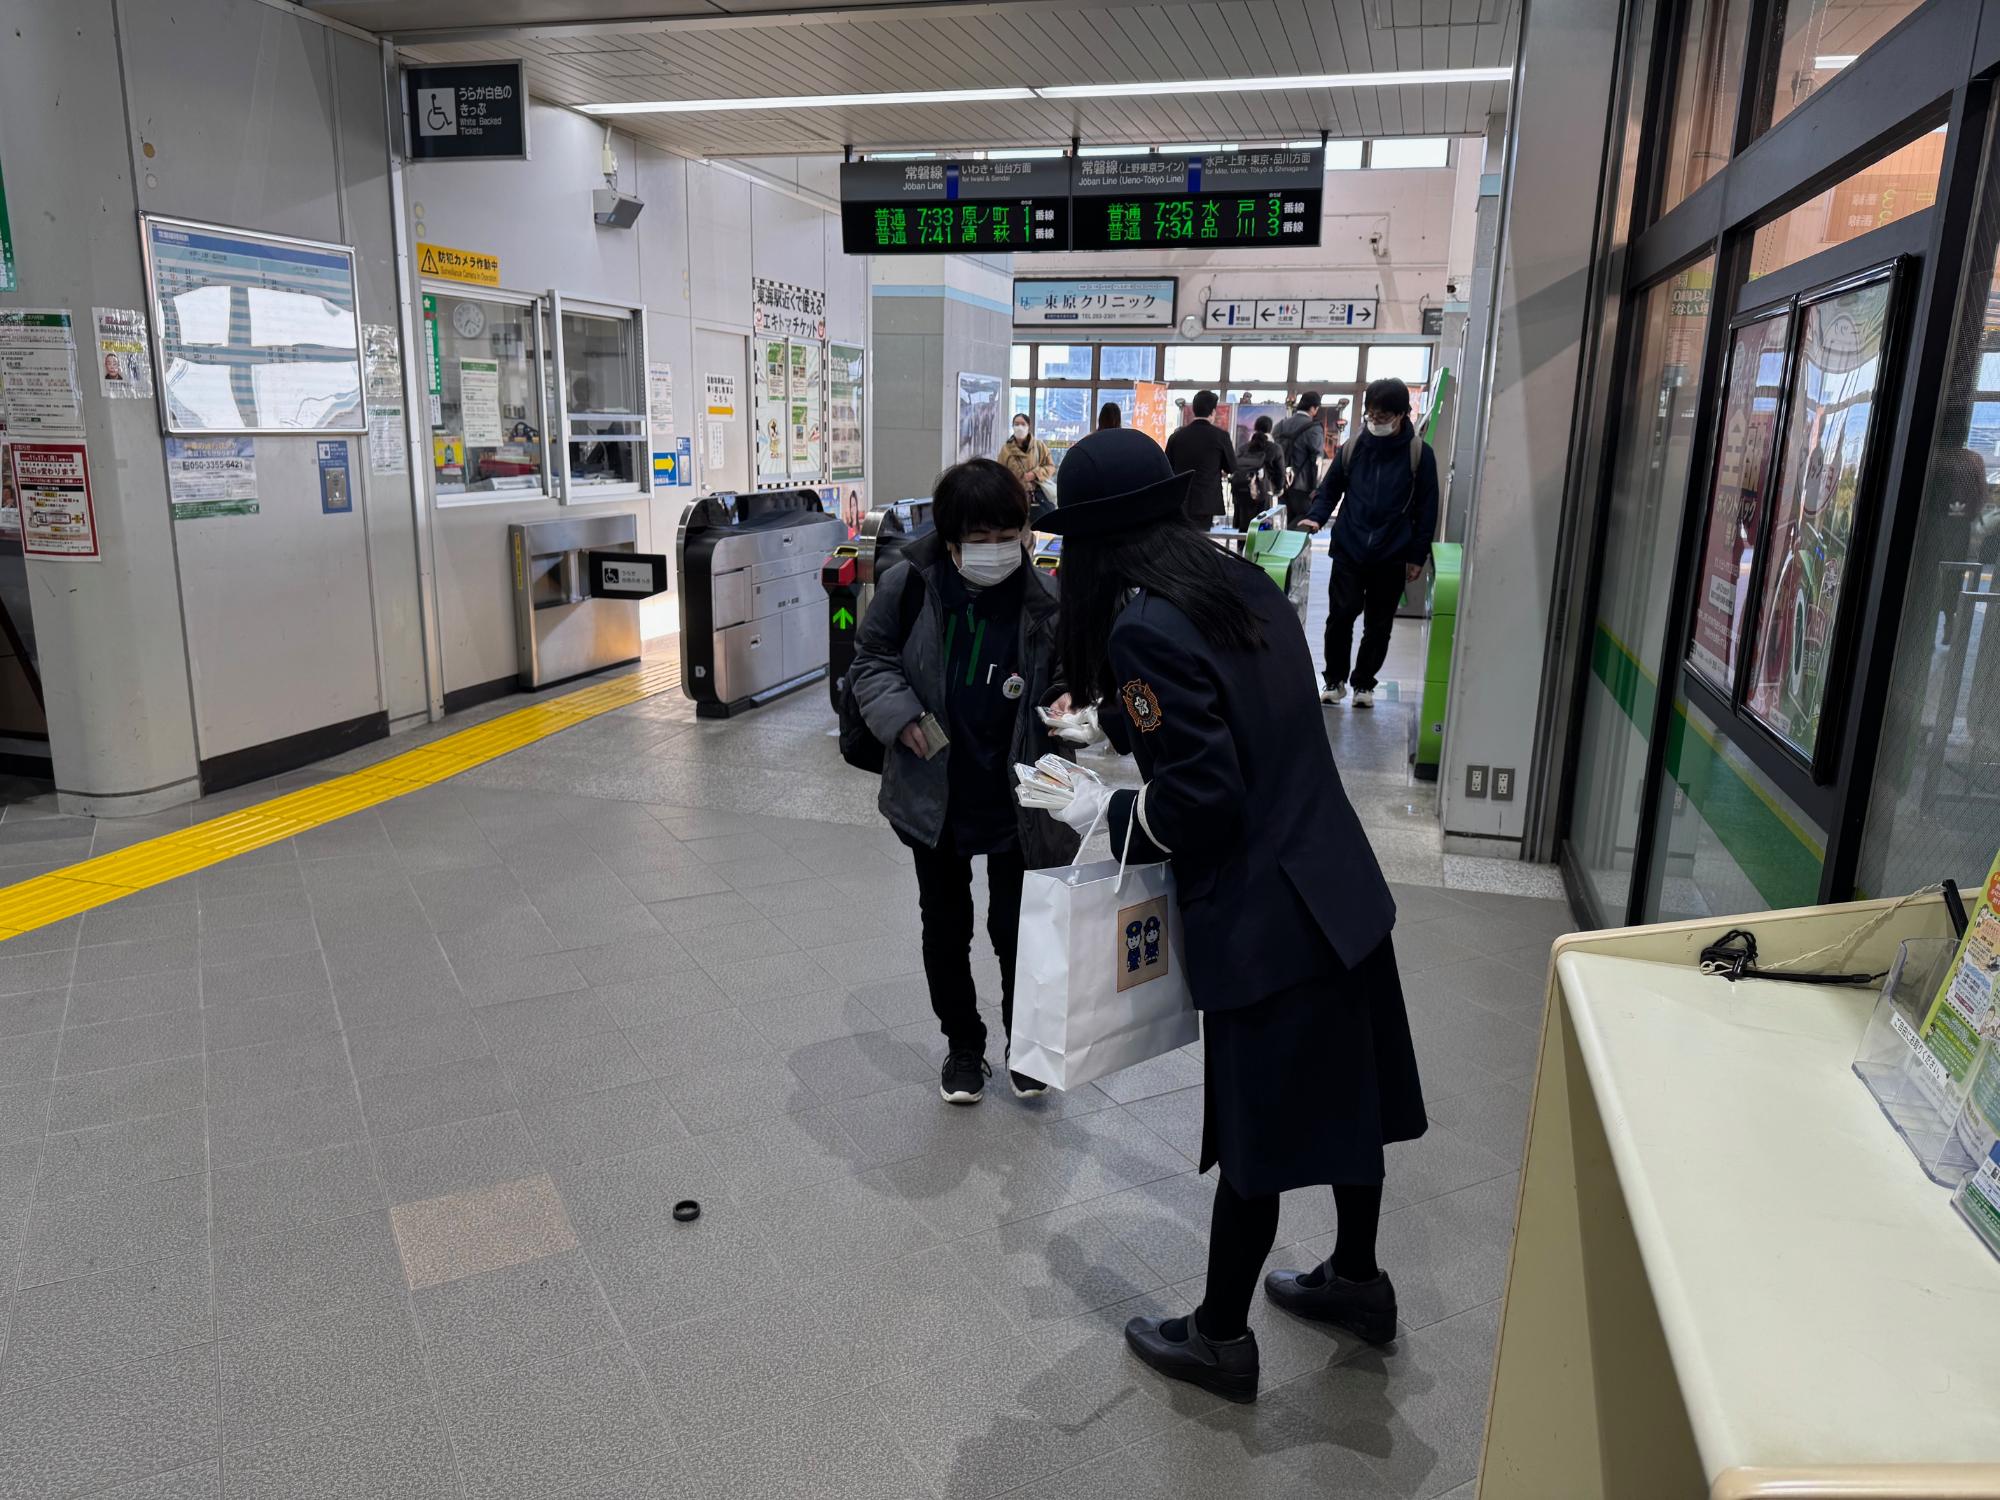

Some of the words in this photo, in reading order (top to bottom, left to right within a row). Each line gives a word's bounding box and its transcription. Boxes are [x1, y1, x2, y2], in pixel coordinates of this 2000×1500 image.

[459, 85, 512, 101] うらが白色の
[460, 103, 487, 116] きっぷ
[905, 166, 943, 180] 常磐線
[962, 163, 1031, 174] いわき・仙台方面
[927, 182, 943, 190] Line
[1102, 175, 1118, 185] Line
[1166, 173, 1185, 184] Line)
[1035, 210, 1055, 221] 番線
[1107, 203, 1142, 222] 普通
[1154, 202, 1194, 221] 7:25
[1268, 199, 1280, 218] 3
[1284, 202, 1305, 214] 番線
[874, 208, 906, 227] 普通
[917, 208, 954, 226] 7:33
[961, 206, 1010, 225] 原ノ町
[1023, 206, 1030, 224] 1
[1035, 228, 1055, 240] 番線
[1108, 223, 1141, 241] 普通
[1153, 221, 1194, 239] 7:34
[1267, 218, 1280, 237] 3
[1283, 221, 1304, 233] 番線
[875, 227, 907, 245] 普通
[918, 227, 952, 244] 7:41
[1023, 225, 1030, 243] 1
[438, 250, 498, 272] 防犯カメラ作動中
[756, 285, 823, 316] 東海駅近くで使える
[1045, 294, 1156, 310] 東原クリニック
[763, 313, 818, 338] エキトマチケット
[190, 461, 243, 470] 050-3355-6421
[1893, 1017, 1942, 1080] ご自由にお取りください。
